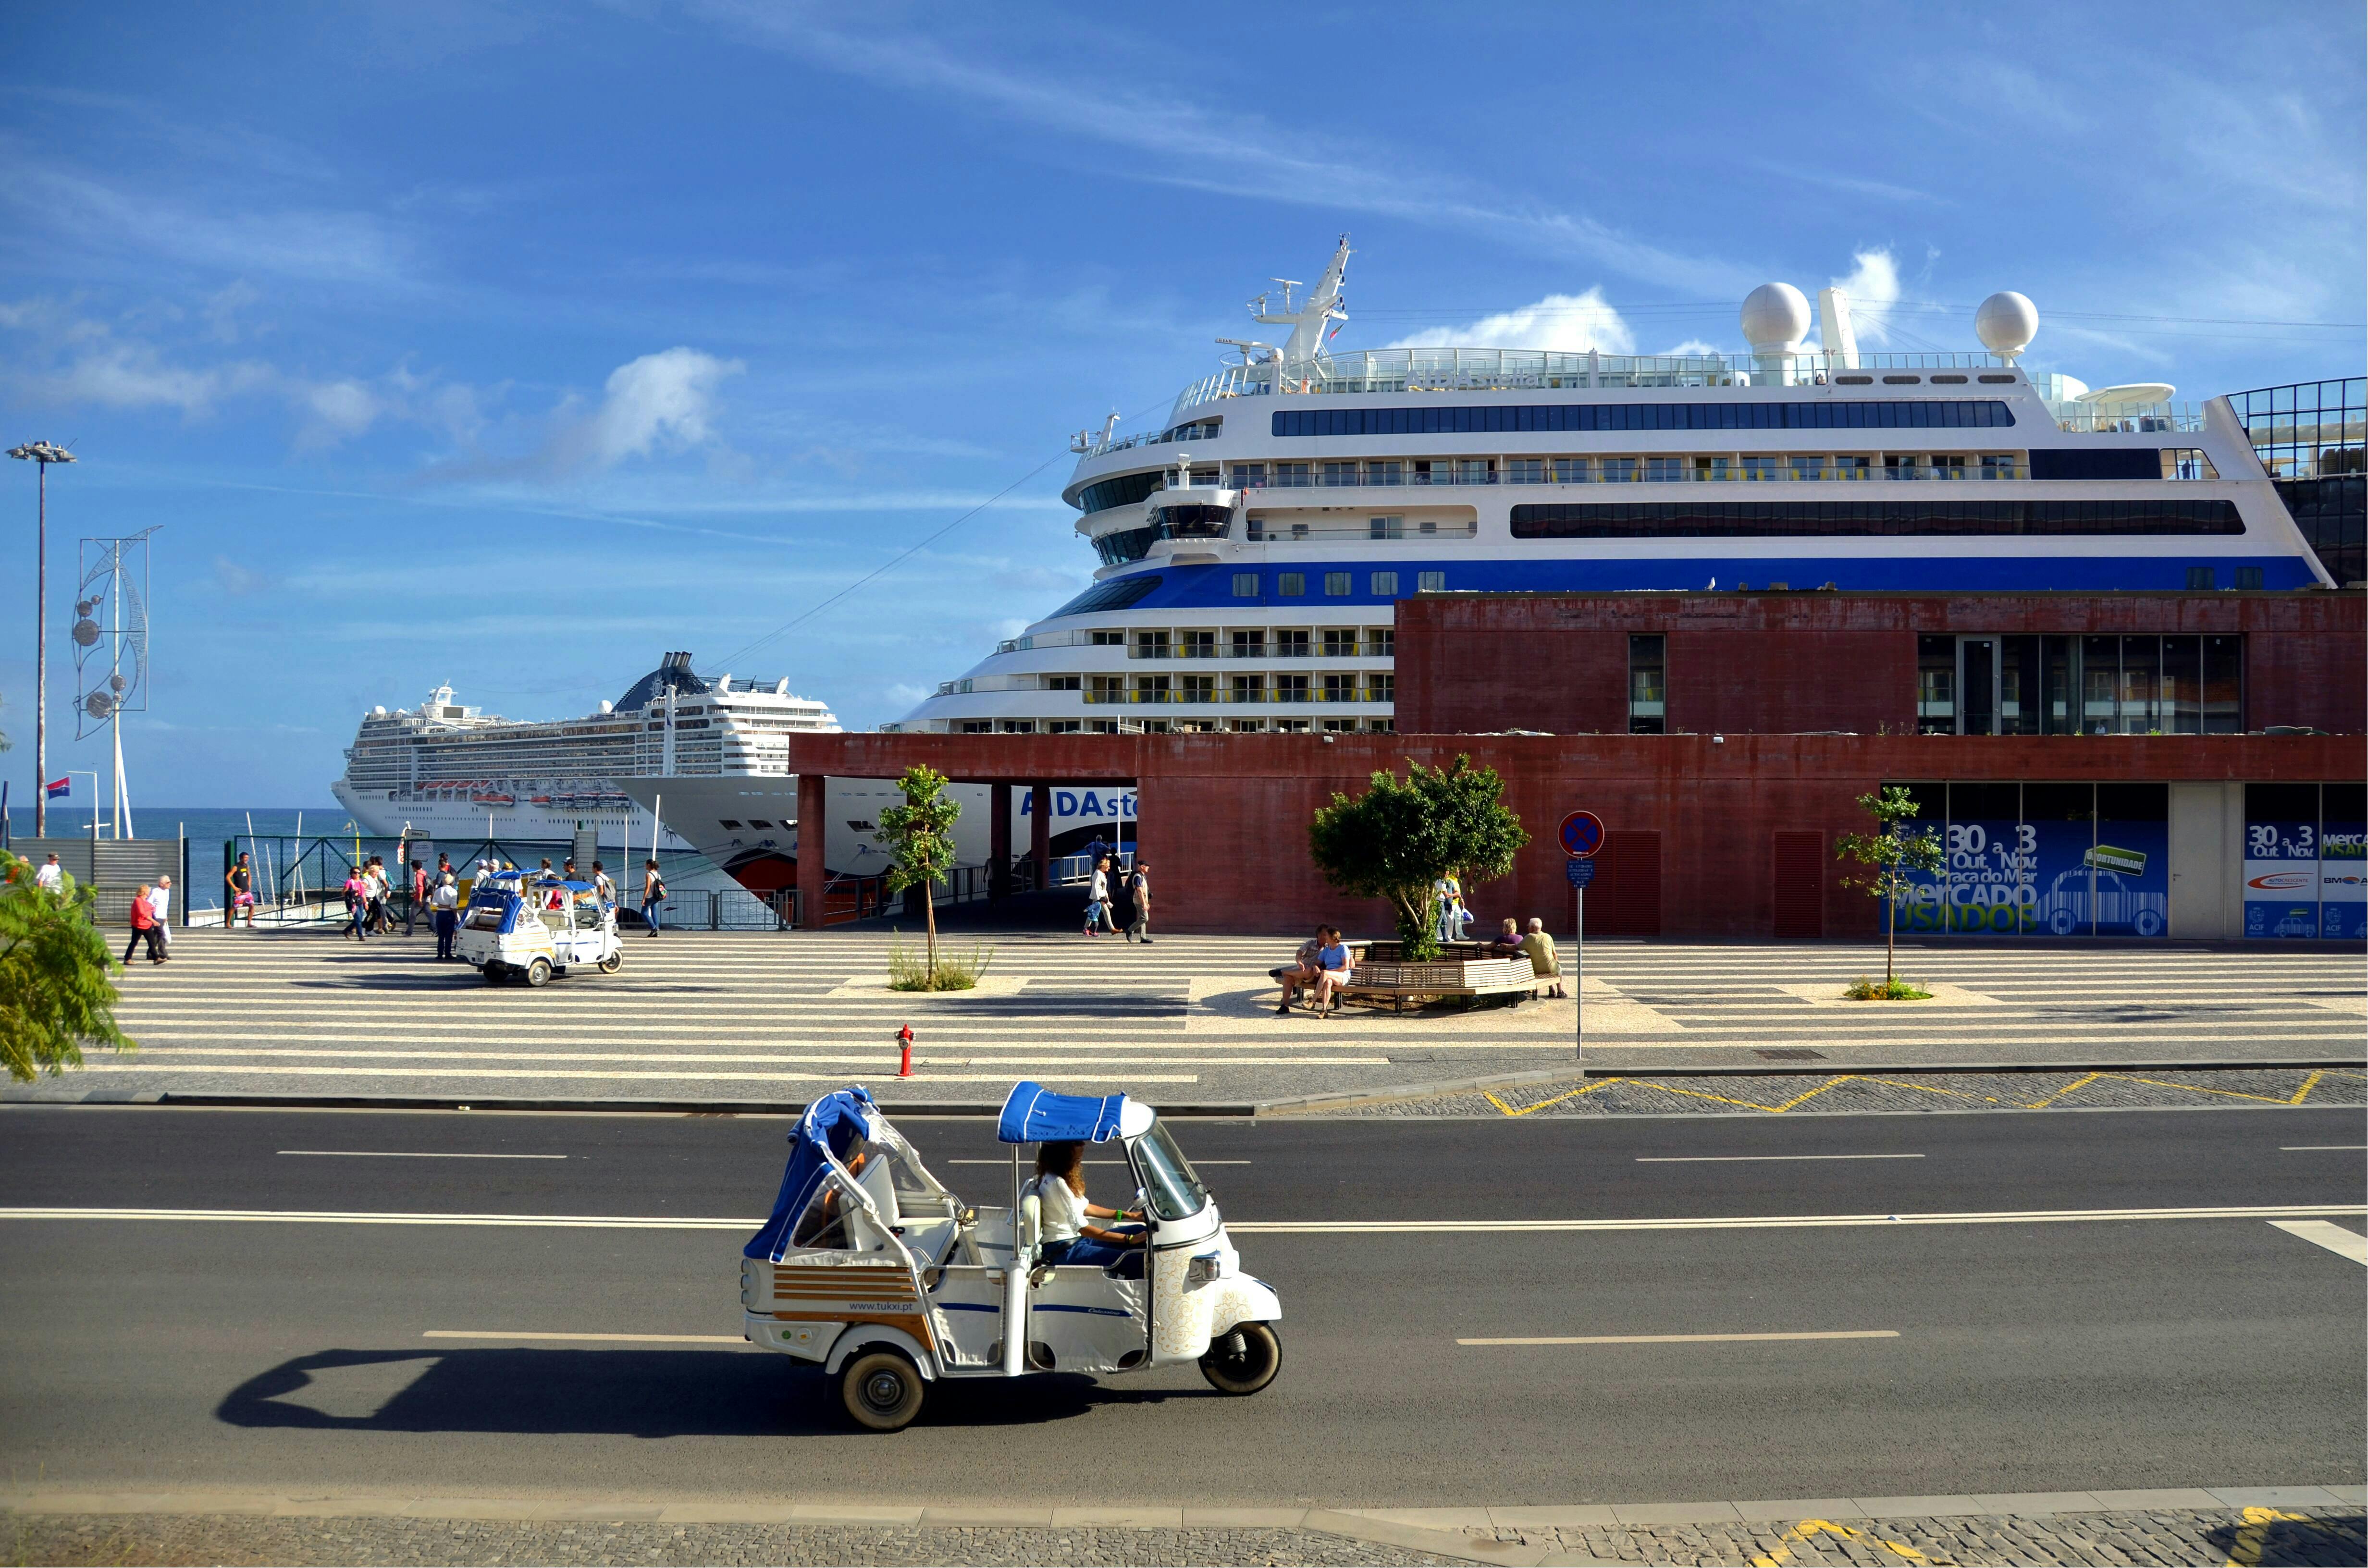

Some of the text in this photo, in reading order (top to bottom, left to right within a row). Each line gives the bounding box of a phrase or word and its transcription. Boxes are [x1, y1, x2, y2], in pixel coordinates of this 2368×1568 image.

[1403, 368, 1538, 387] AIDAstella
[1020, 791, 1137, 816] ADAst
[1949, 824, 2037, 854] 30 a 3
[2249, 825, 2314, 846] 30 a 3
[1953, 852, 2037, 870] Out. Nov.
[2086, 851, 2143, 870] OORTUNIDADE
[2253, 845, 2314, 858] Out. Nov.
[1980, 868, 2002, 883] do
[2004, 869, 2037, 883] Mar
[1891, 904, 2037, 932] USADOS
[849, 1301, 913, 1312] www.tukxi.pt
